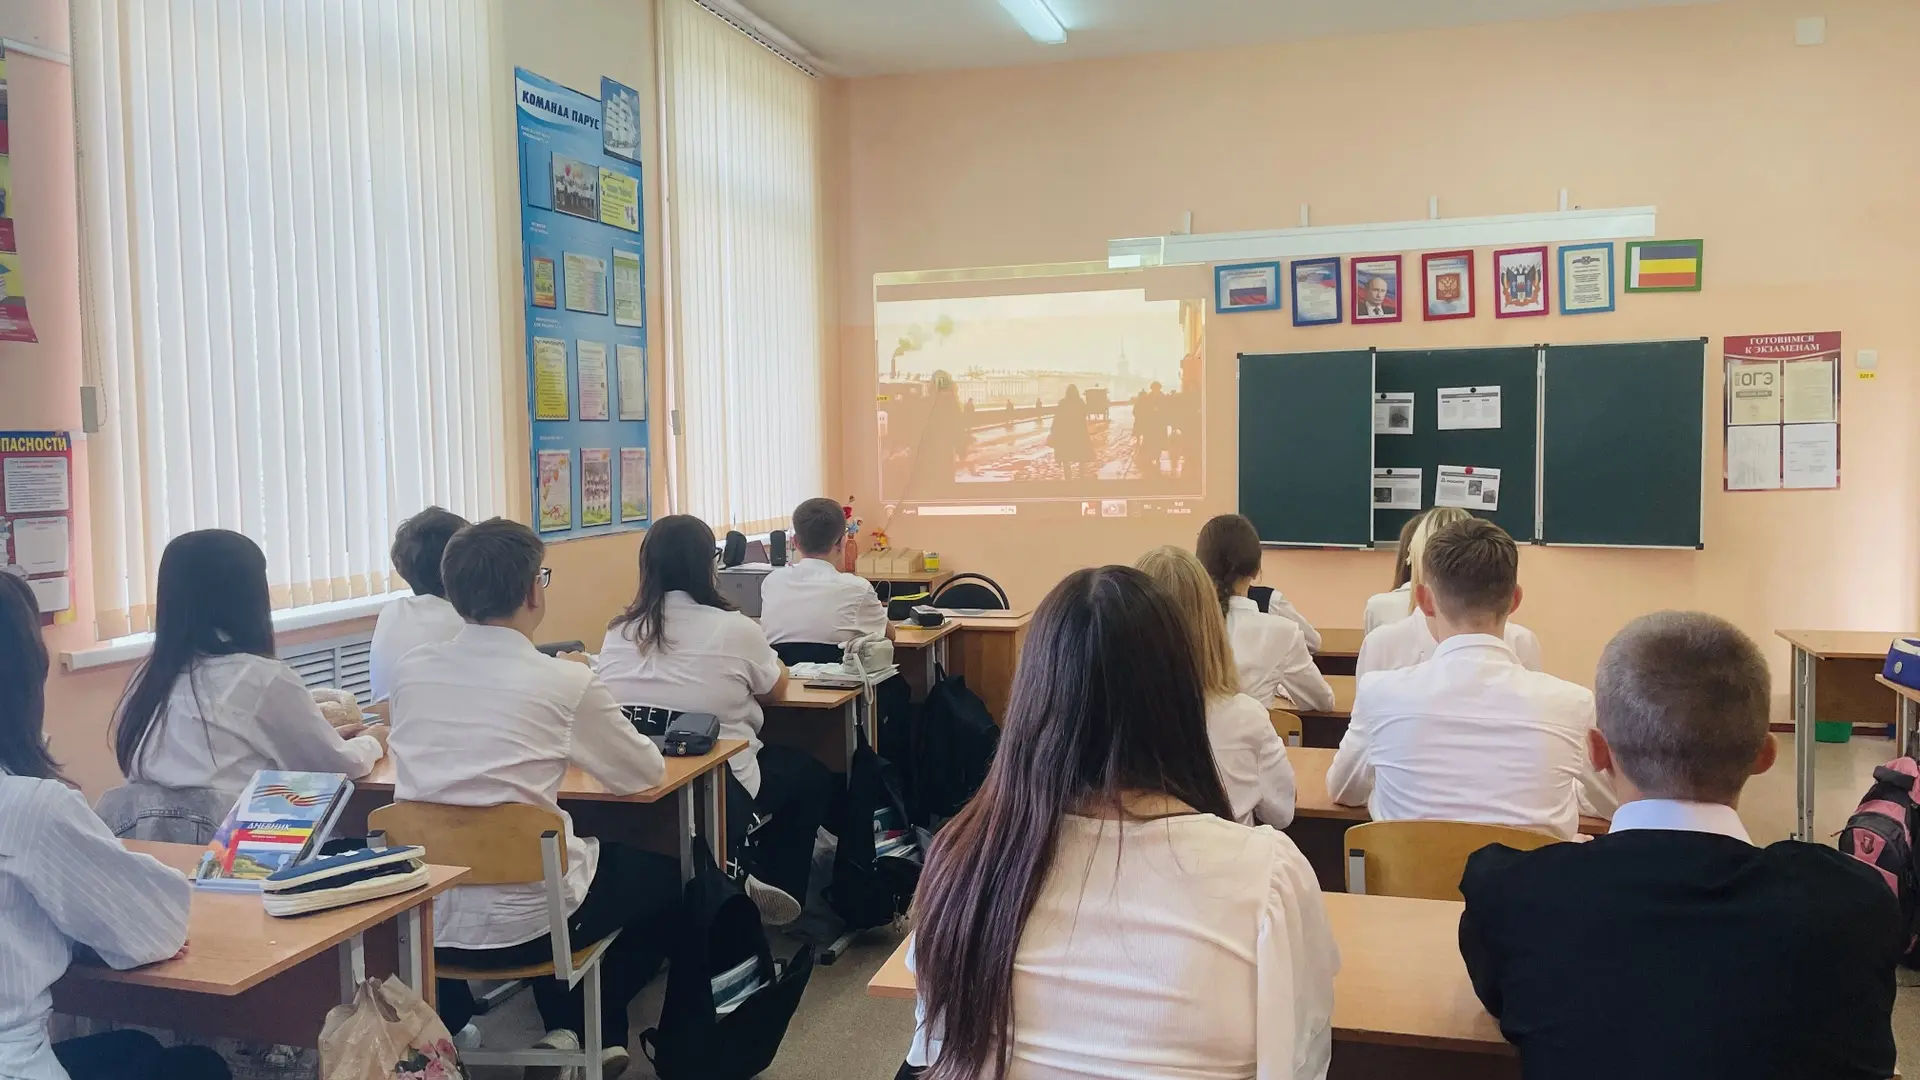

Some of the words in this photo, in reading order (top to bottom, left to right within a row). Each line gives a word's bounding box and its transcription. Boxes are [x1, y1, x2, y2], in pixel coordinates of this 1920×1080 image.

[522, 90, 569, 119] КОМАНДА
[572, 110, 600, 130] ПАРУС
[1750, 335, 1815, 345] ГОТОВИМСЯ
[1745, 346, 1752, 354] К
[1754, 343, 1820, 353] ЭКЗАМЕНАМ
[1741, 372, 1773, 386] ОГЭ
[247, 822, 292, 831] ДНЕВНИК
